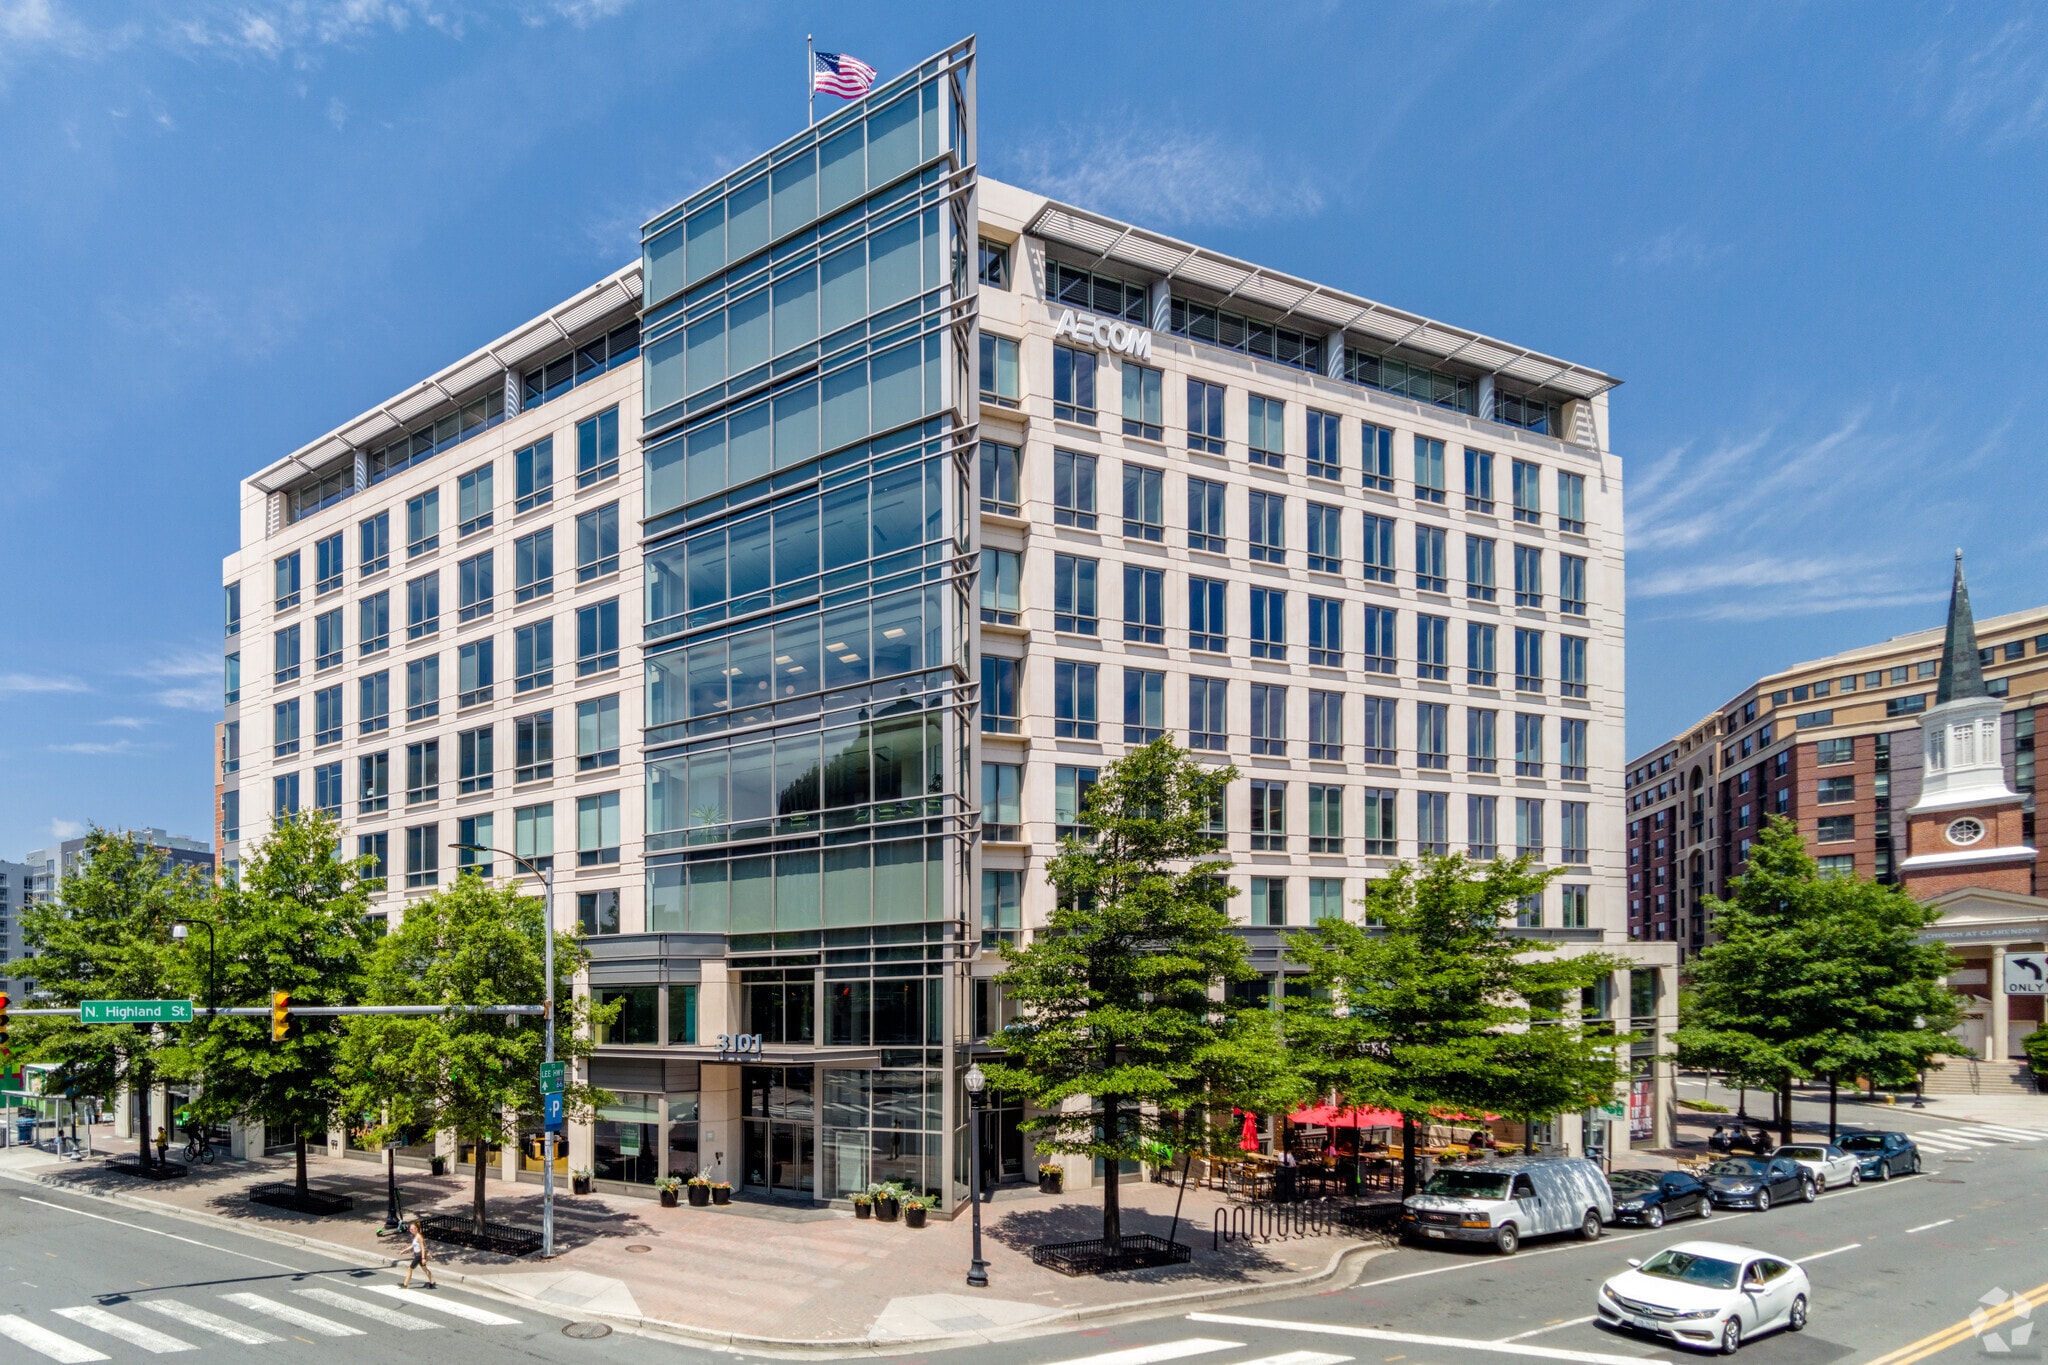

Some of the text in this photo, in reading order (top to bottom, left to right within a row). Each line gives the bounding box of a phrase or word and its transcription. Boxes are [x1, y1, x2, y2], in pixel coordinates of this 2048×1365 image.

[1055, 308, 1152, 360] AECOM
[1925, 931, 1963, 940] CHURCH
[1980, 927, 2041, 936] CLARENDON
[2008, 983, 2045, 992] ONLY
[84, 1005, 189, 1020] N. Highland St.
[715, 1033, 763, 1053] 3101
[541, 1069, 564, 1078] LEE HWY
[552, 1100, 560, 1118] P
